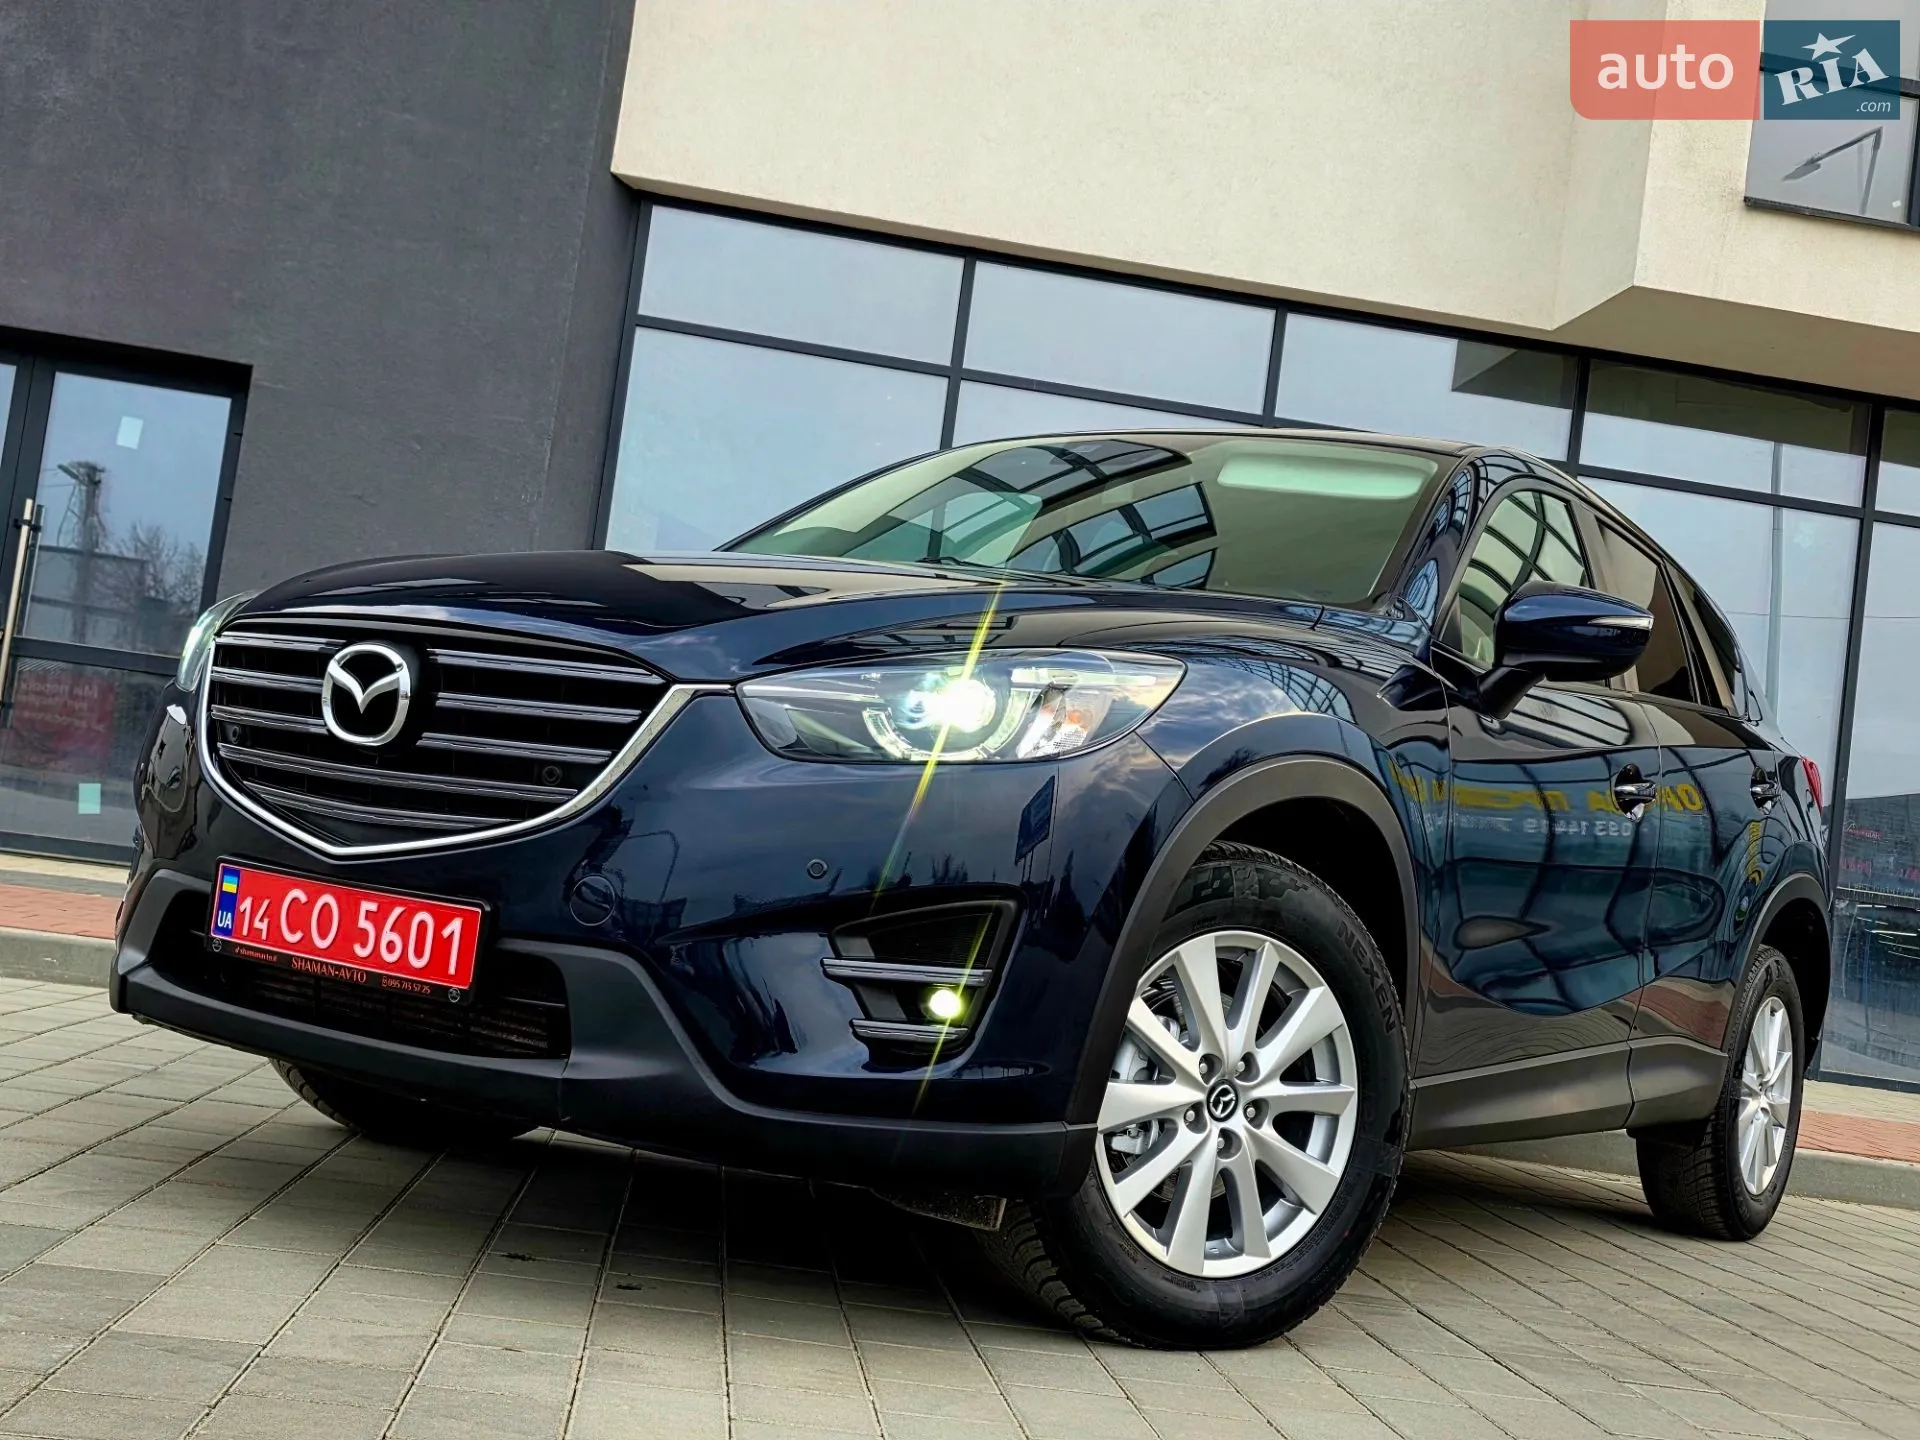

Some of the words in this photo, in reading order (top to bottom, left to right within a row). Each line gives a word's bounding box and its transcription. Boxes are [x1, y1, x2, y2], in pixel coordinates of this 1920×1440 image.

[217, 910, 232, 929] UA
[239, 896, 271, 940] 14
[280, 888, 340, 950] CO
[352, 900, 464, 976] 5601
[291, 956, 366, 983] SHAMAN-AVTO
[1337, 919, 1397, 1035] NEXEN
